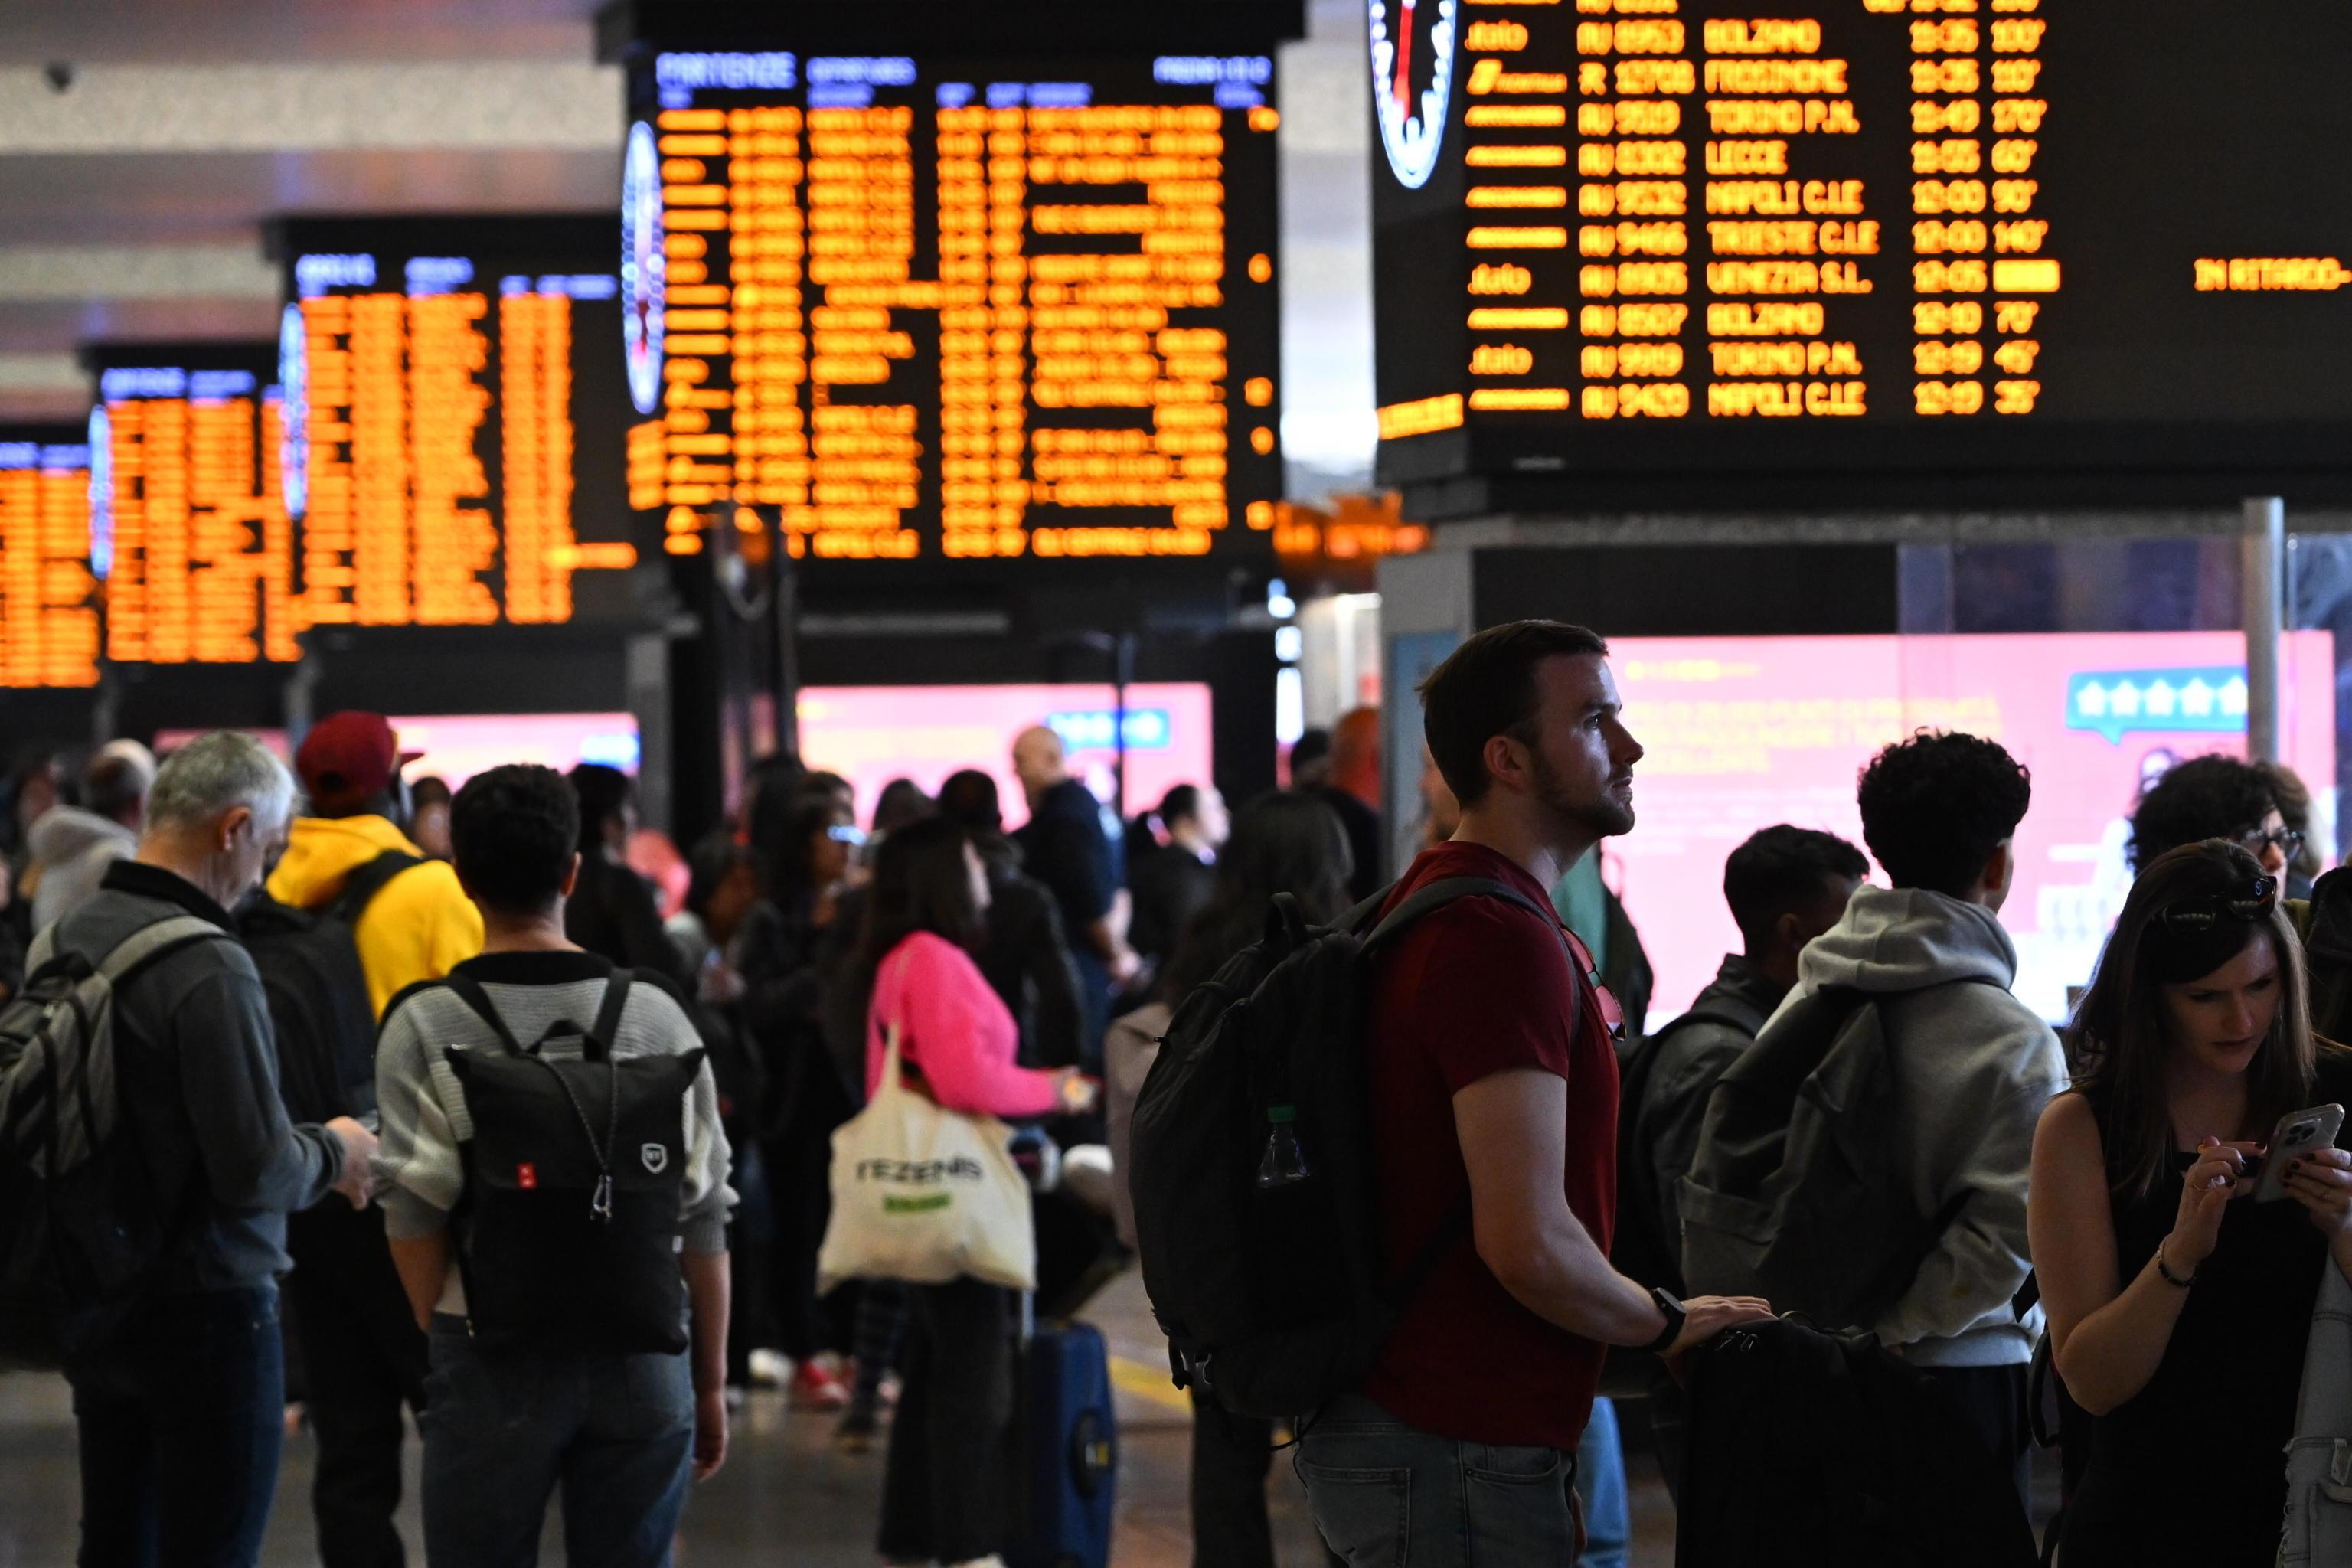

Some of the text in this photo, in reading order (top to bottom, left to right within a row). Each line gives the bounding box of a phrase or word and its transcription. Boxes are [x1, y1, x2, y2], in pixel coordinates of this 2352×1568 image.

[1704, 18, 1821, 53] BOLZANO
[1578, 62, 1607, 95] R
[1704, 58, 1847, 93] FROSINONE
[1705, 99, 1803, 134] TORINO
[1705, 139, 1788, 175] LECCE
[1706, 179, 1801, 214] NAPOLI
[1707, 220, 1818, 255] TRIESTE
[1707, 259, 1819, 296] VENEZIA
[1820, 259, 1873, 296] S.L.
[2194, 258, 2227, 291] IN
[1707, 301, 1824, 335] BOLZANO
[1708, 340, 1805, 376] TORINO
[1708, 380, 1803, 416] NAPOLI
